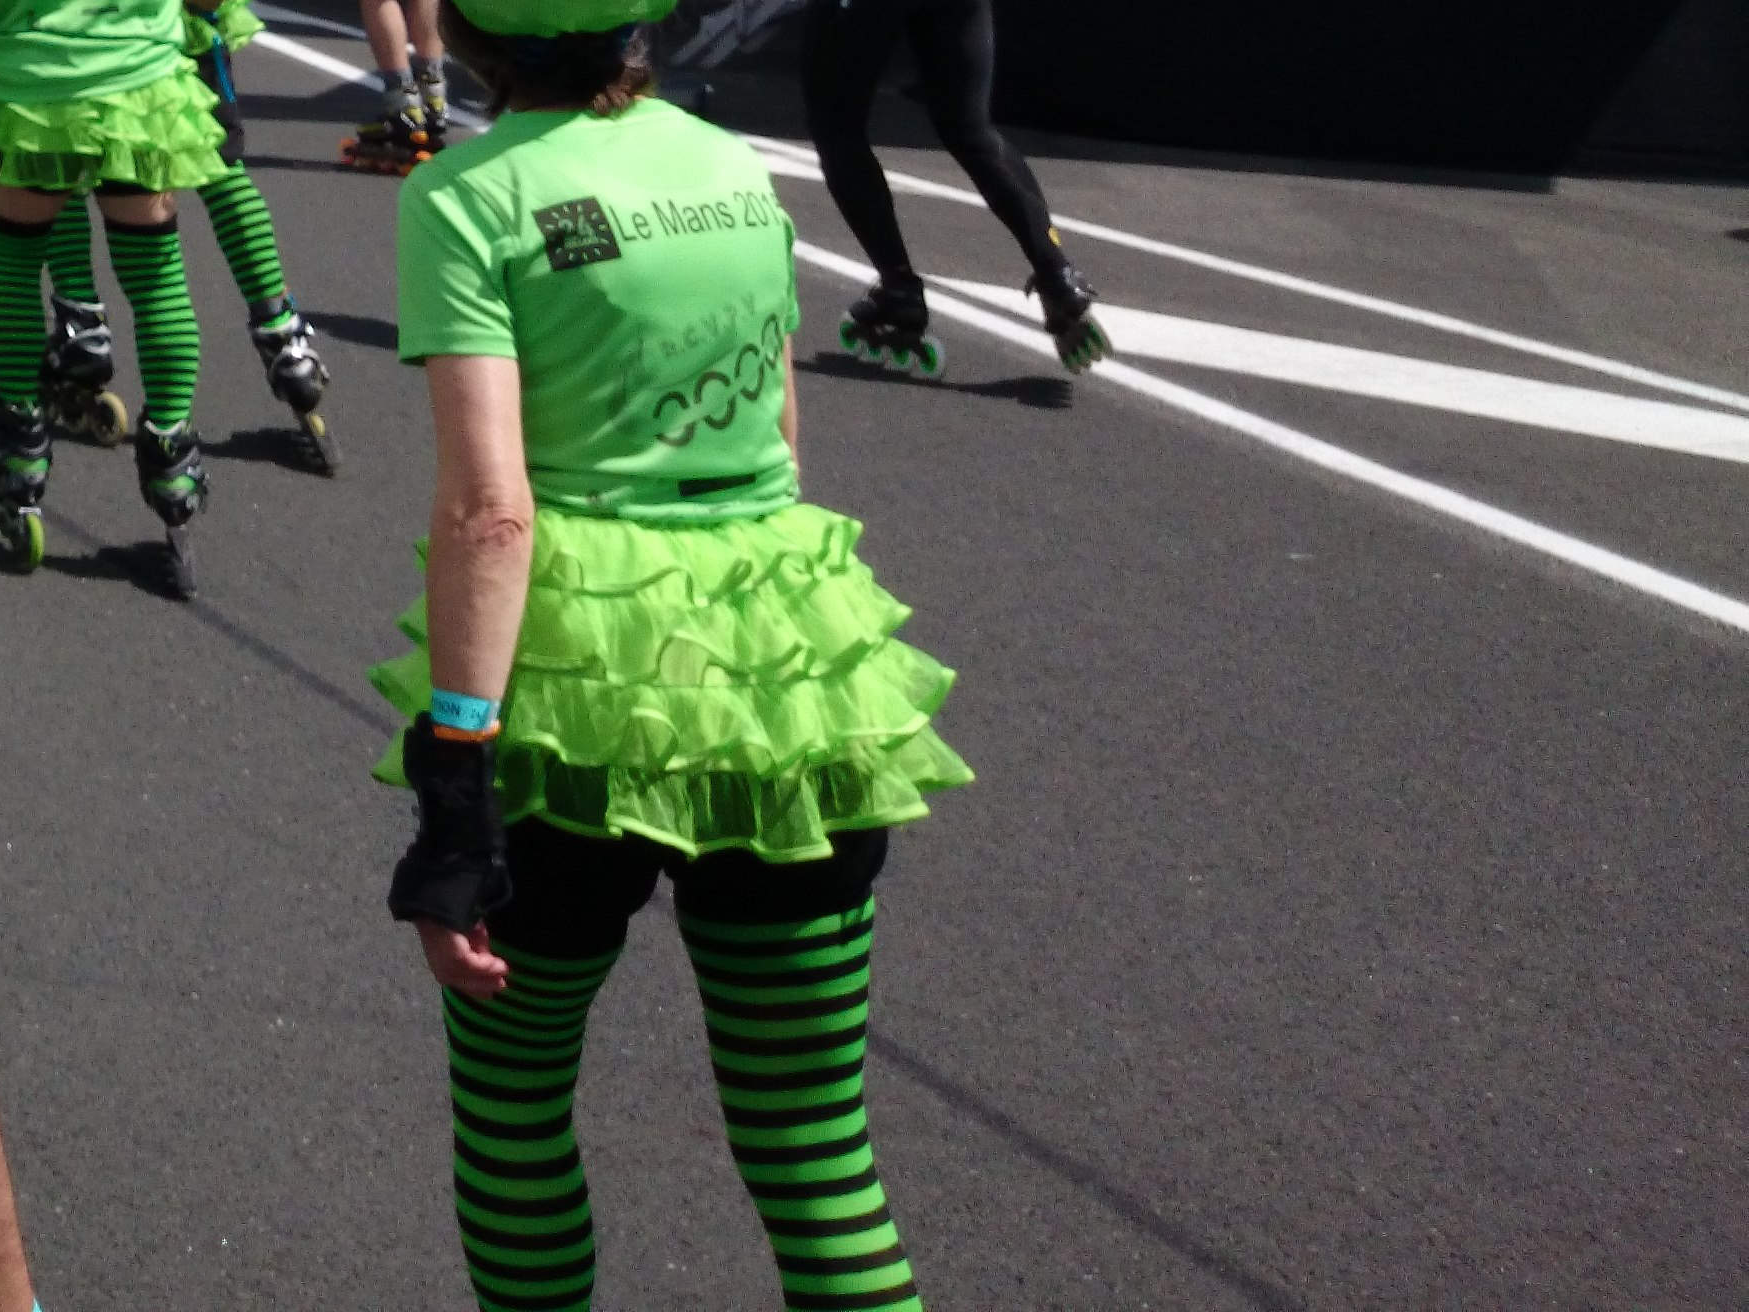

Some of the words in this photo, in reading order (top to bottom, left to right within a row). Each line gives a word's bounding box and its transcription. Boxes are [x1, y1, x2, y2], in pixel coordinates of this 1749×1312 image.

[608, 205, 652, 242] Le
[651, 200, 736, 237] Mans
[733, 190, 787, 228] 201
